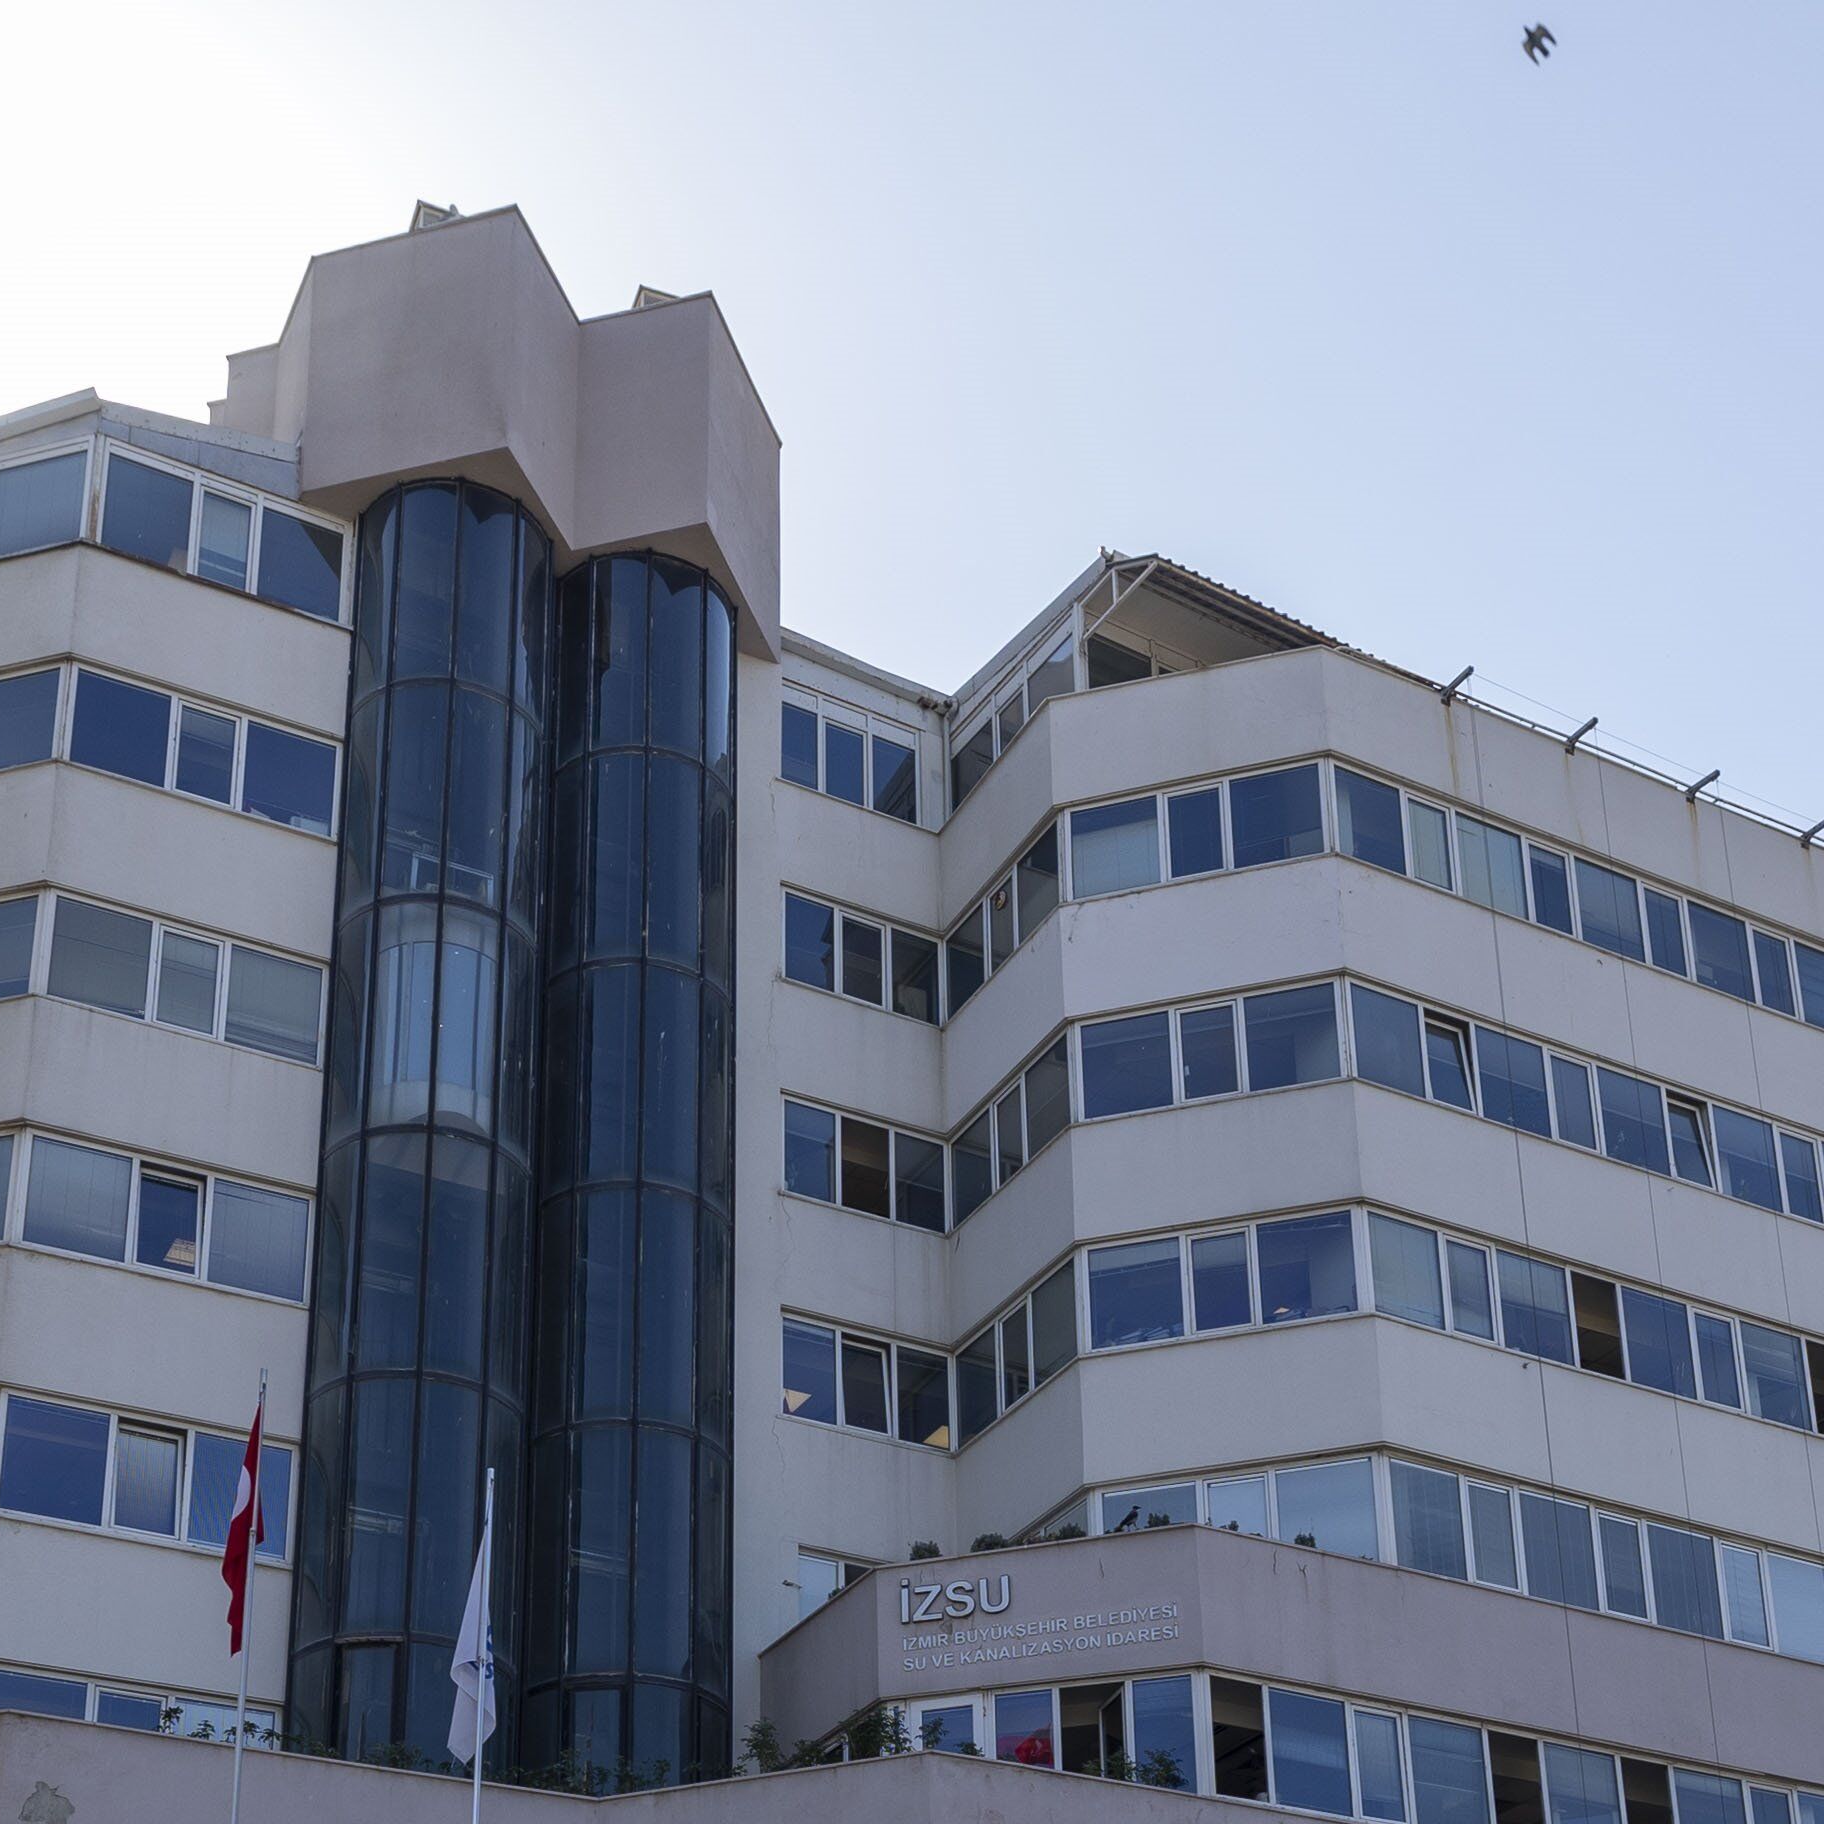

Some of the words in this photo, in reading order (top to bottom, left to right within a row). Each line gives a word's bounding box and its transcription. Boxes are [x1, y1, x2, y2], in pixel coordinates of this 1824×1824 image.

[899, 1574, 1011, 1624] İZSU
[1073, 1600, 1178, 1629] BELEDİYESİ
[903, 1656, 927, 1672] SU
[931, 1652, 955, 1668] VE
[1106, 1622, 1180, 1647] İDARESİ
